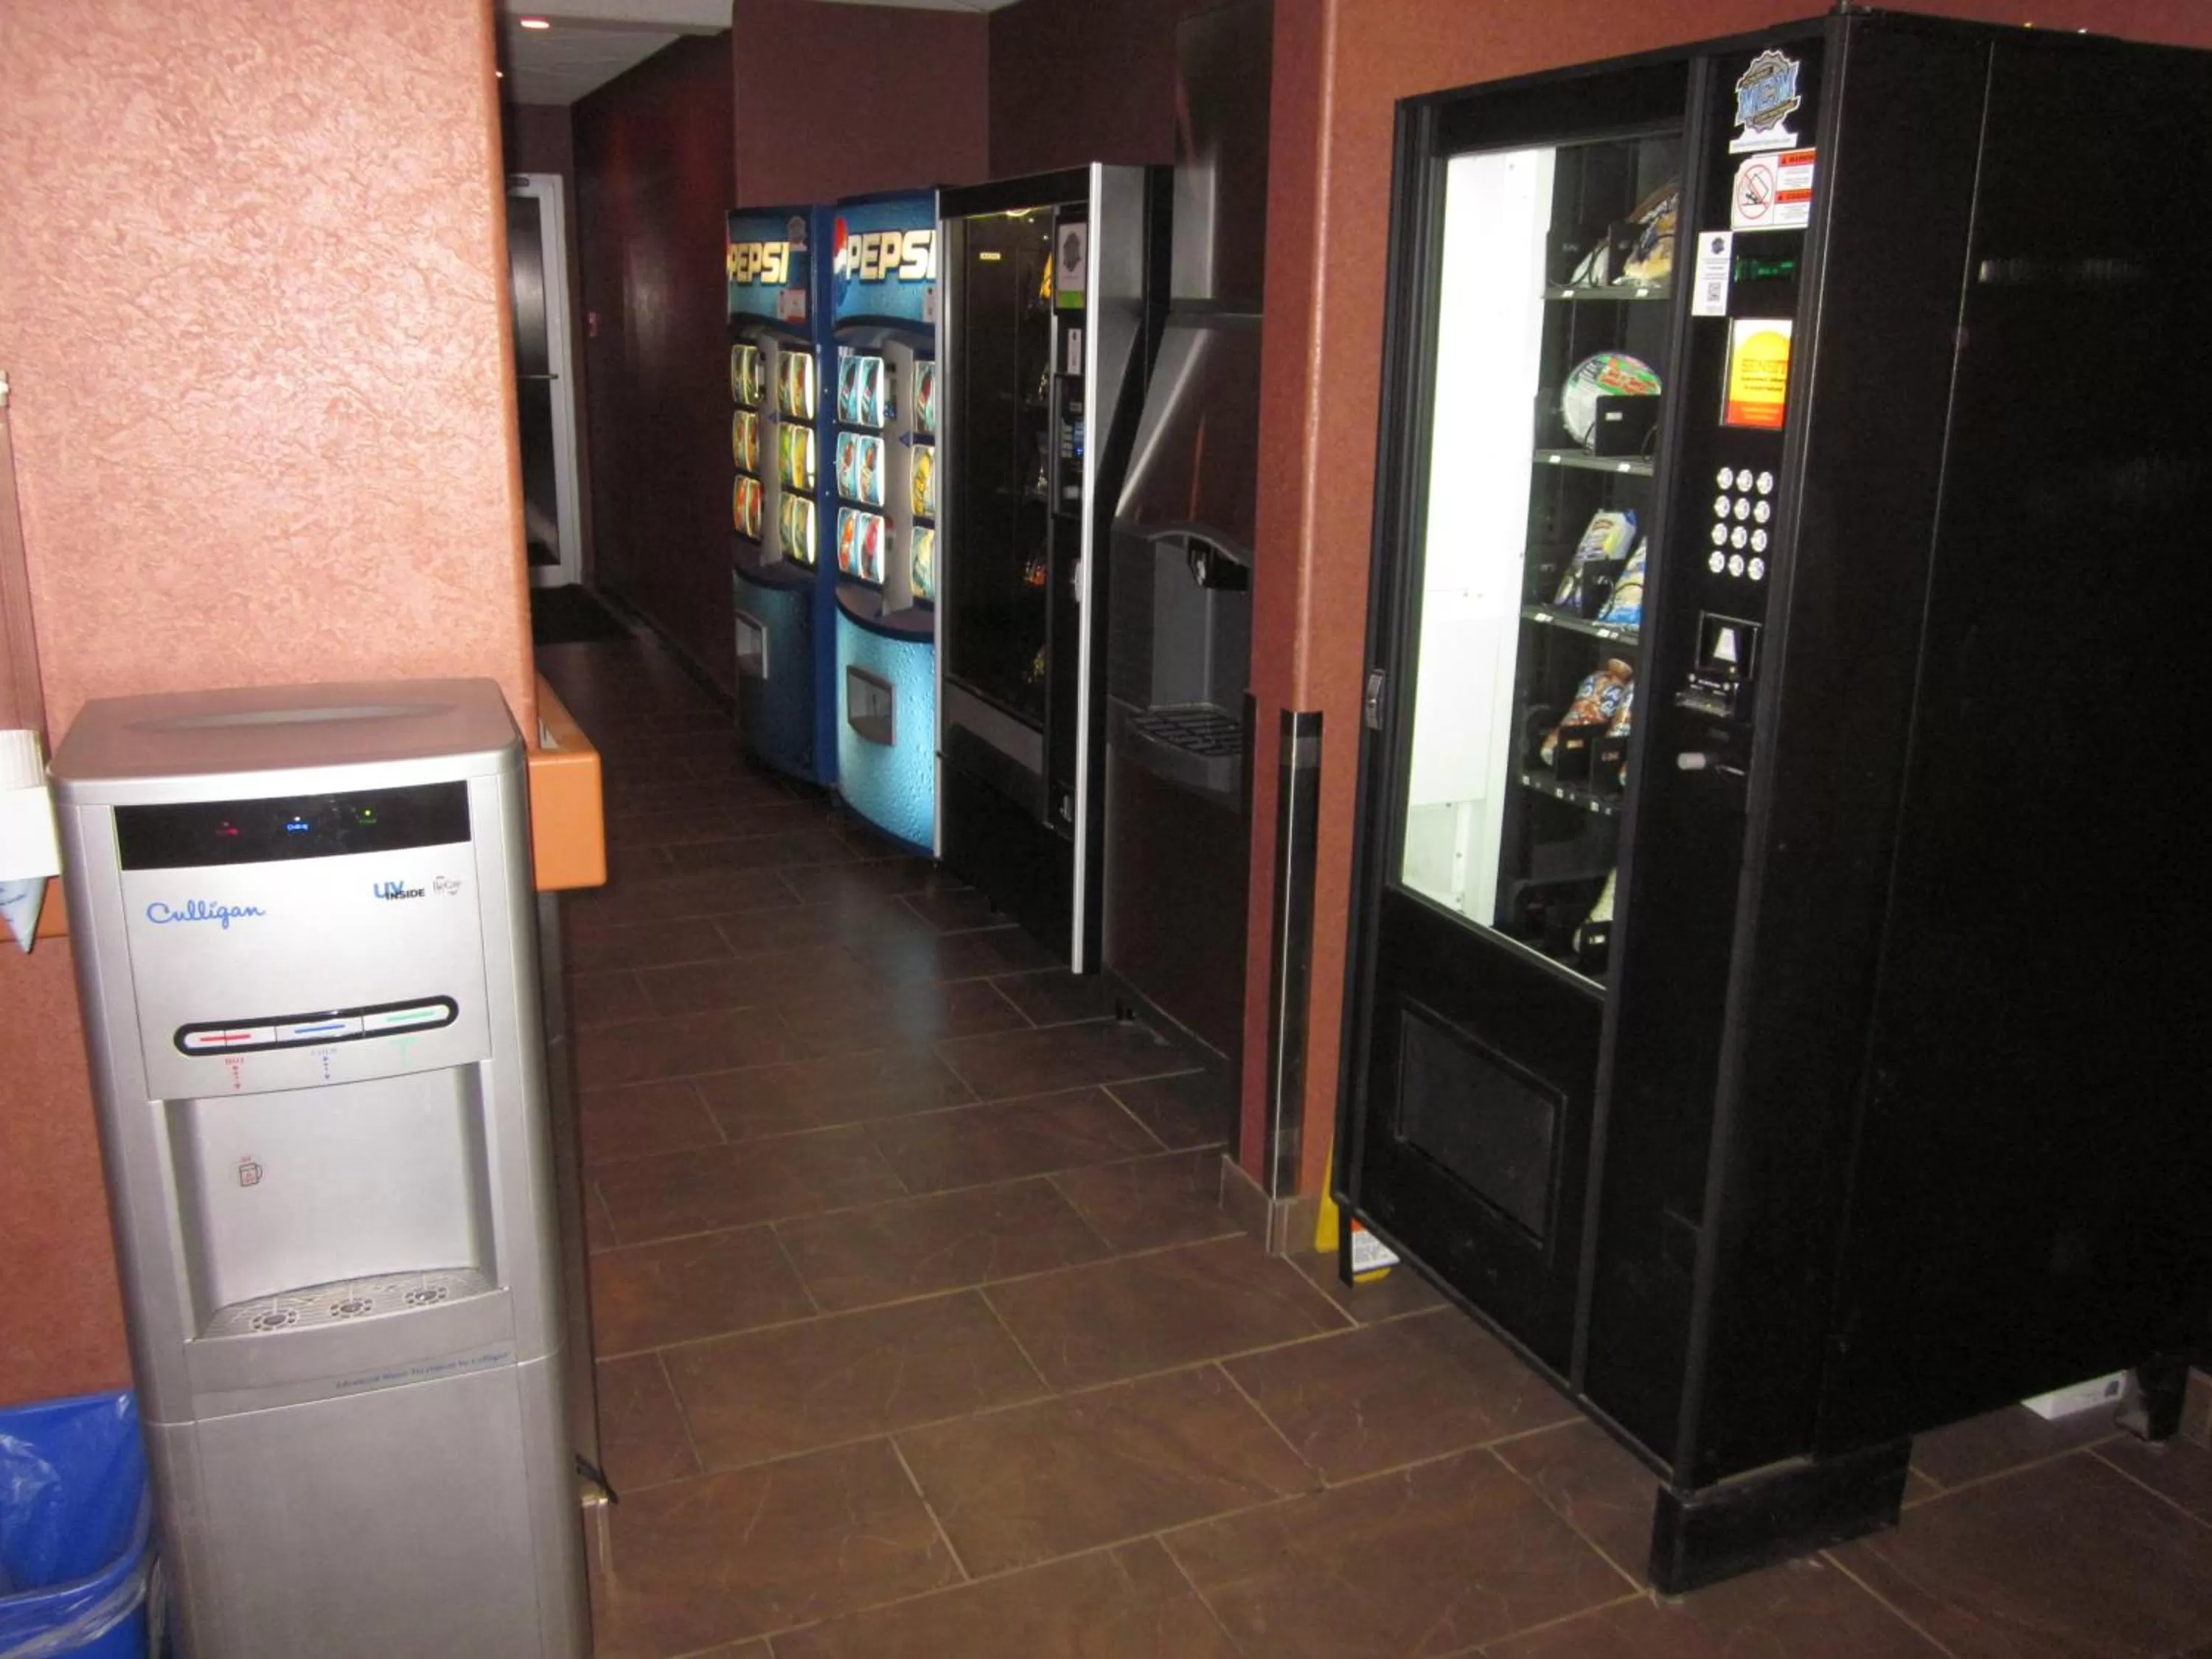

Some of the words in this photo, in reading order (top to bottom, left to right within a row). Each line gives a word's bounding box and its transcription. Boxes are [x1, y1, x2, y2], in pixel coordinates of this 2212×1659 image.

[728, 241, 790, 283] PEPSI
[846, 229, 936, 280] PEPSI
[373, 880, 404, 898] UV
[386, 888, 425, 900] INSIDE
[147, 900, 266, 929] Culligan
